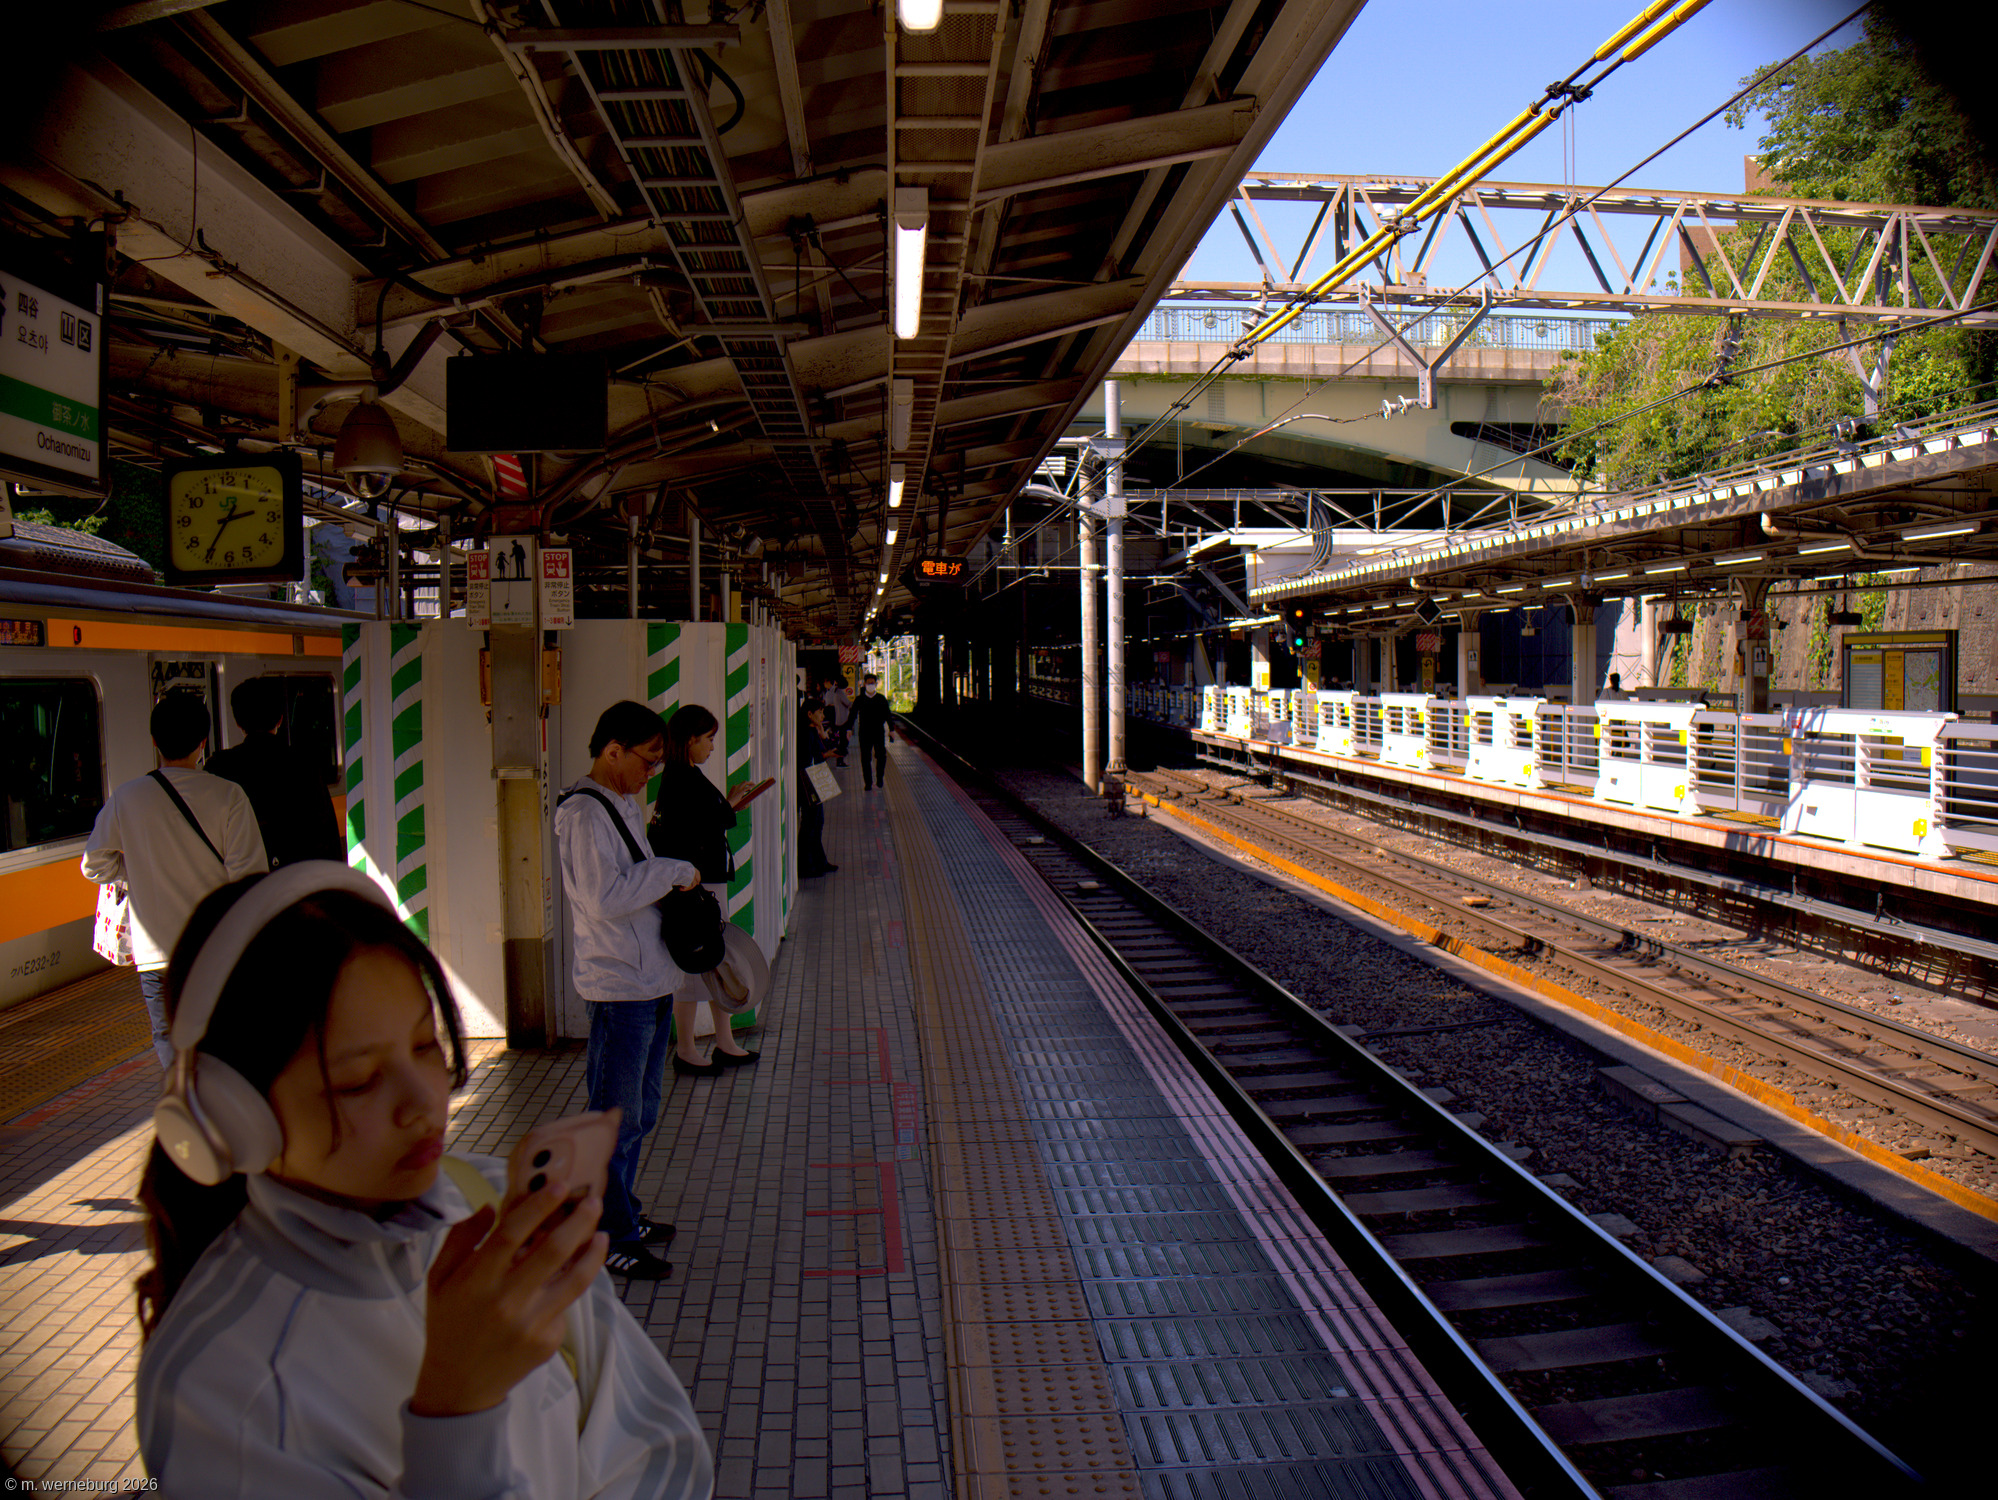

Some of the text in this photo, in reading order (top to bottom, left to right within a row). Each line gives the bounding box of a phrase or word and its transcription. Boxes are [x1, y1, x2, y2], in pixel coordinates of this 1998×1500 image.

[18, 292, 39, 320] 四谷
[17, 325, 48, 354] 요츠야
[52, 400, 90, 432] 御茶ノ水
[37, 431, 91, 462] Ochanomizu
[220, 476, 236, 486] 12
[244, 480, 249, 489] 1
[204, 483, 217, 494] 11
[219, 496, 237, 507] JR
[258, 491, 268, 502] 2
[189, 497, 203, 508] 10
[181, 516, 192, 527] 9
[266, 511, 276, 523] 3
[189, 536, 200, 548] 8
[258, 533, 268, 544] 4
[224, 551, 235, 562] 6
[242, 546, 253, 558] 5
[544, 553, 568, 561] STOP
[469, 554, 488, 562] STOP
[921, 560, 962, 576] 電車が
[544, 581, 569, 589] 非常停止
[551, 590, 570, 598] ボタン
[10, 950, 61, 978] クハE232-22
